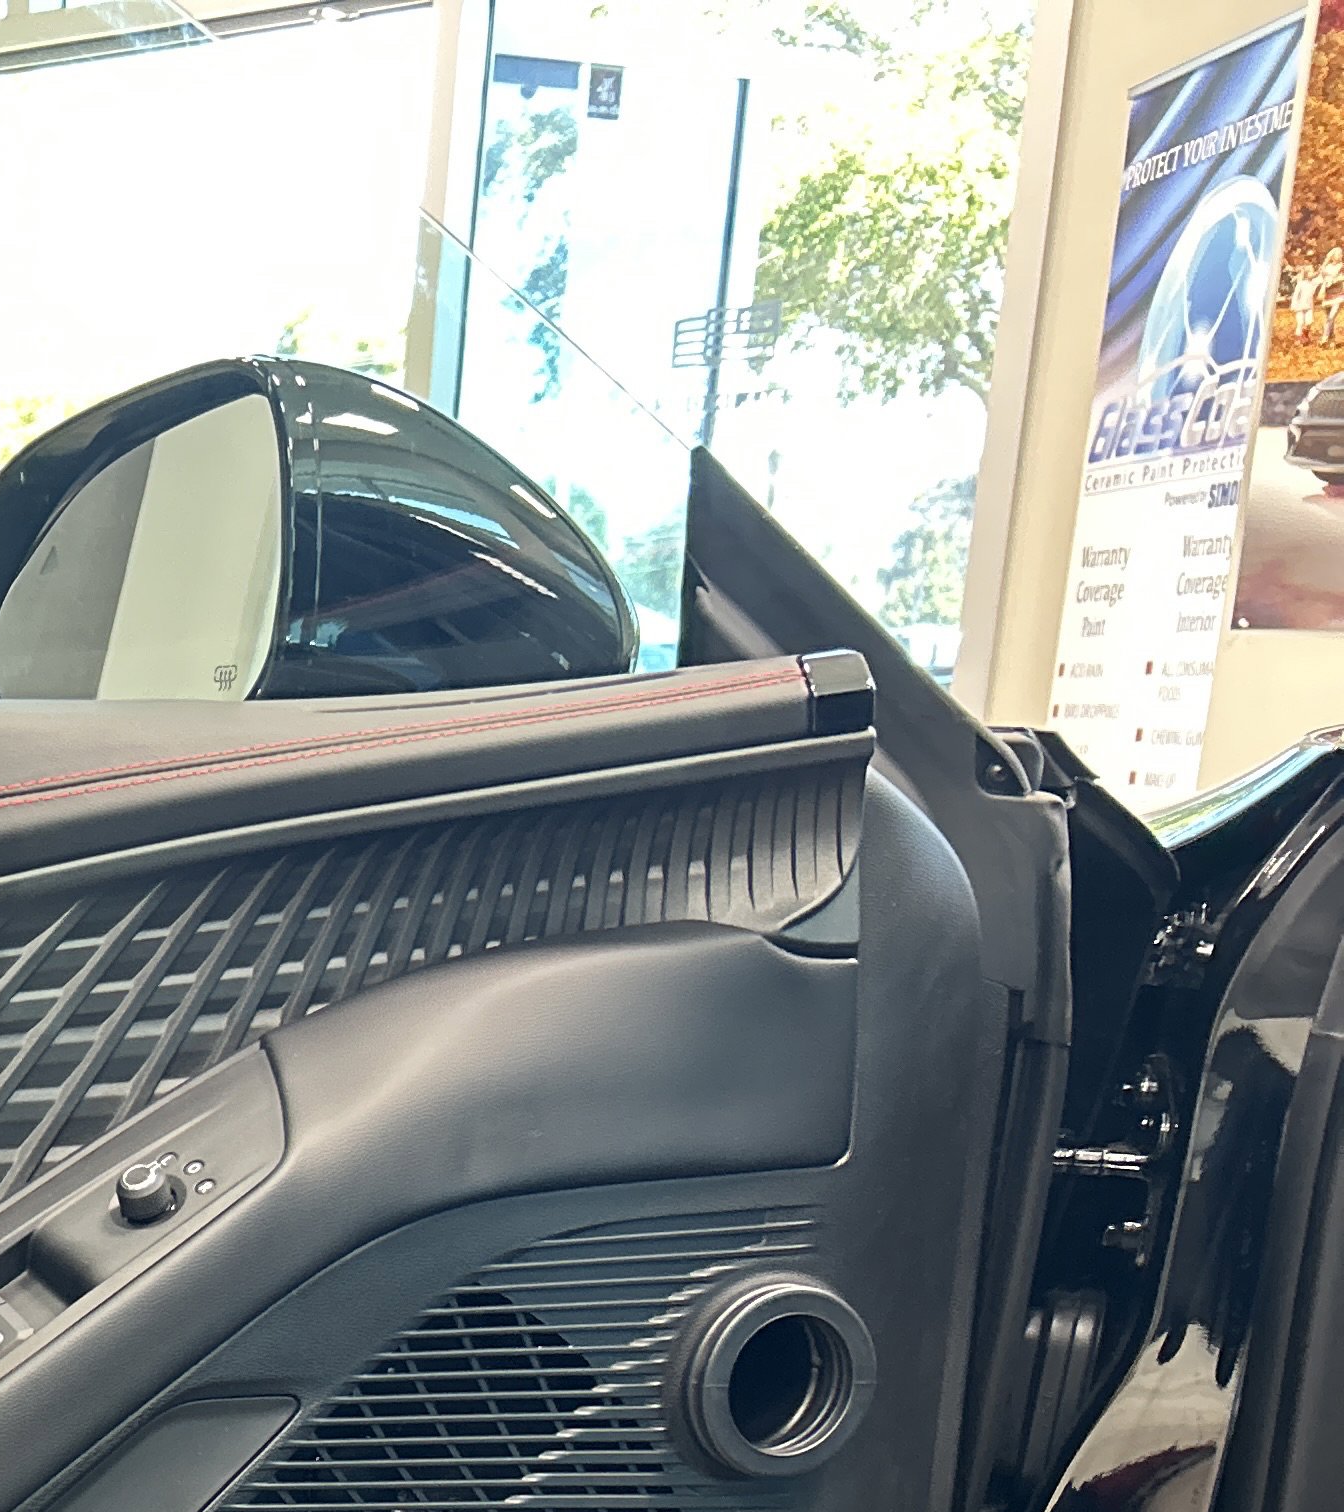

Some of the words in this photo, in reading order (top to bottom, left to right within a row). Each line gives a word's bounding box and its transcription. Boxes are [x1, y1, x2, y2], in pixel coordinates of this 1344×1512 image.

[1124, 145, 1182, 191] PROTECT
[1183, 132, 1219, 168] YOUR
[1085, 471, 1135, 491] Ceramic
[1142, 462, 1173, 481] Paint
[1081, 546, 1131, 571] Warranty
[1183, 534, 1232, 561] Warranty
[1076, 580, 1125, 608] Coverage
[1176, 572, 1229, 600] Coverage
[1081, 616, 1106, 638] Paint
[1175, 611, 1217, 633] Interior
